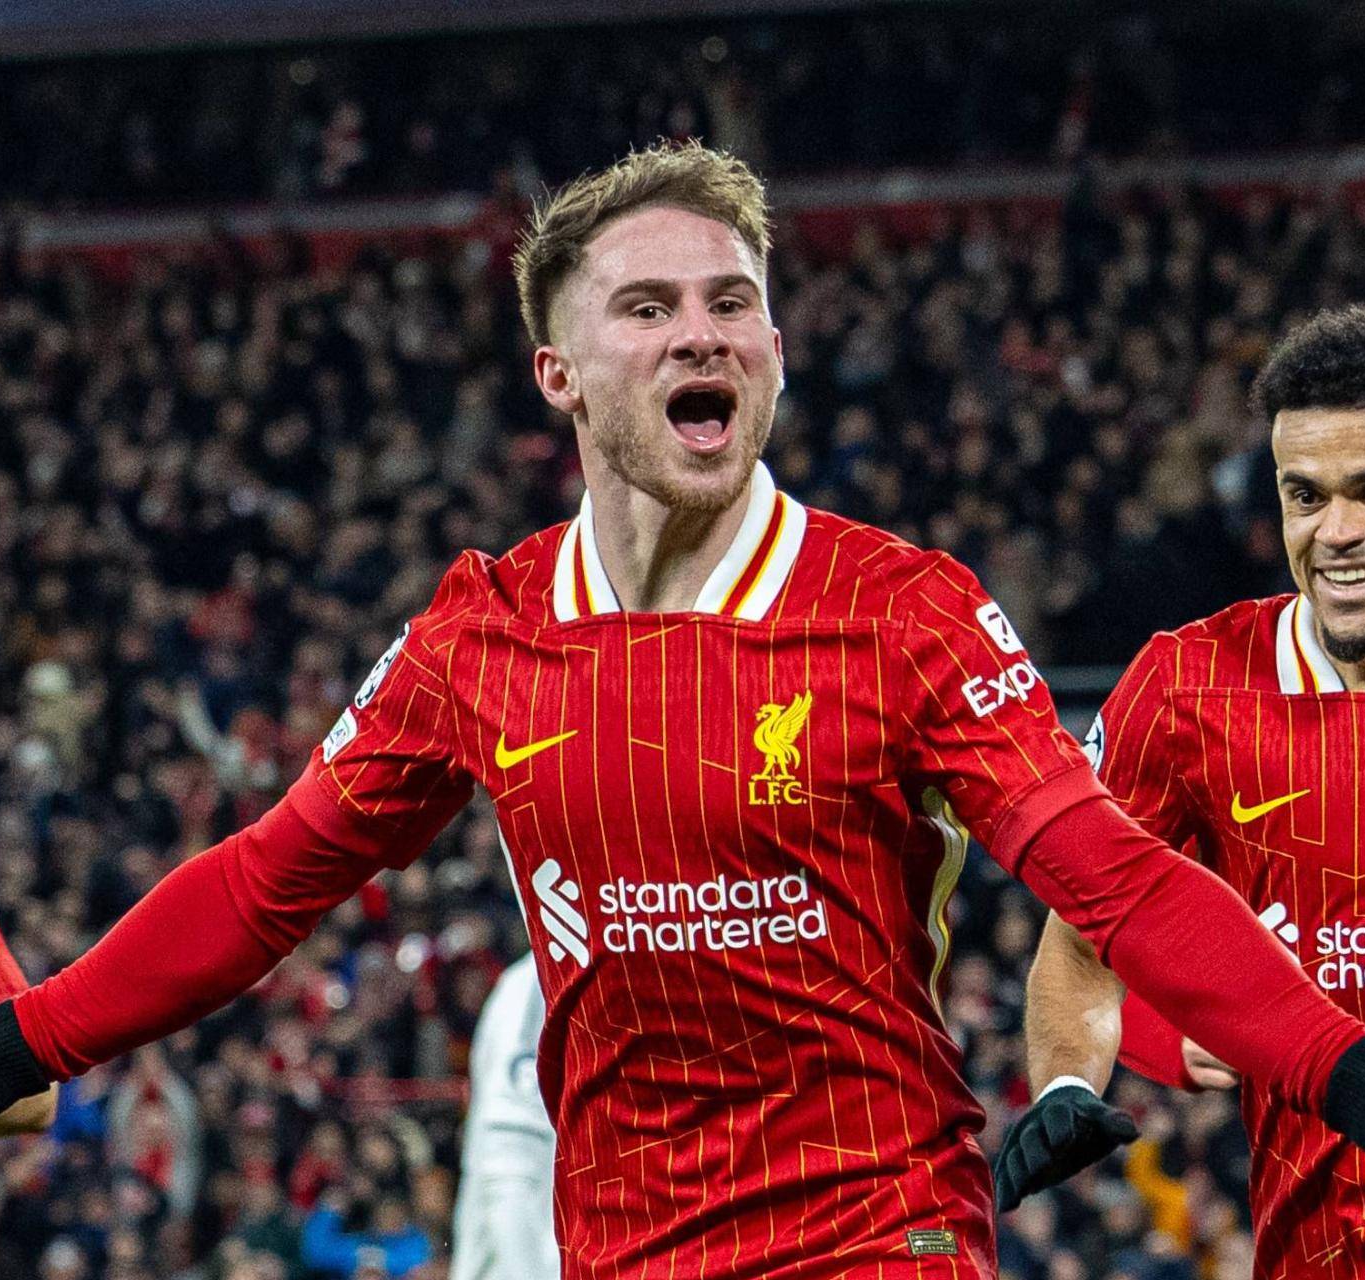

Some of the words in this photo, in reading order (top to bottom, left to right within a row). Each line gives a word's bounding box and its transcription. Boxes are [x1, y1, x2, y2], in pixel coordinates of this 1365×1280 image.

[961, 659, 1045, 717] Exp
[599, 867, 809, 914] standard
[603, 900, 828, 953] chartered
